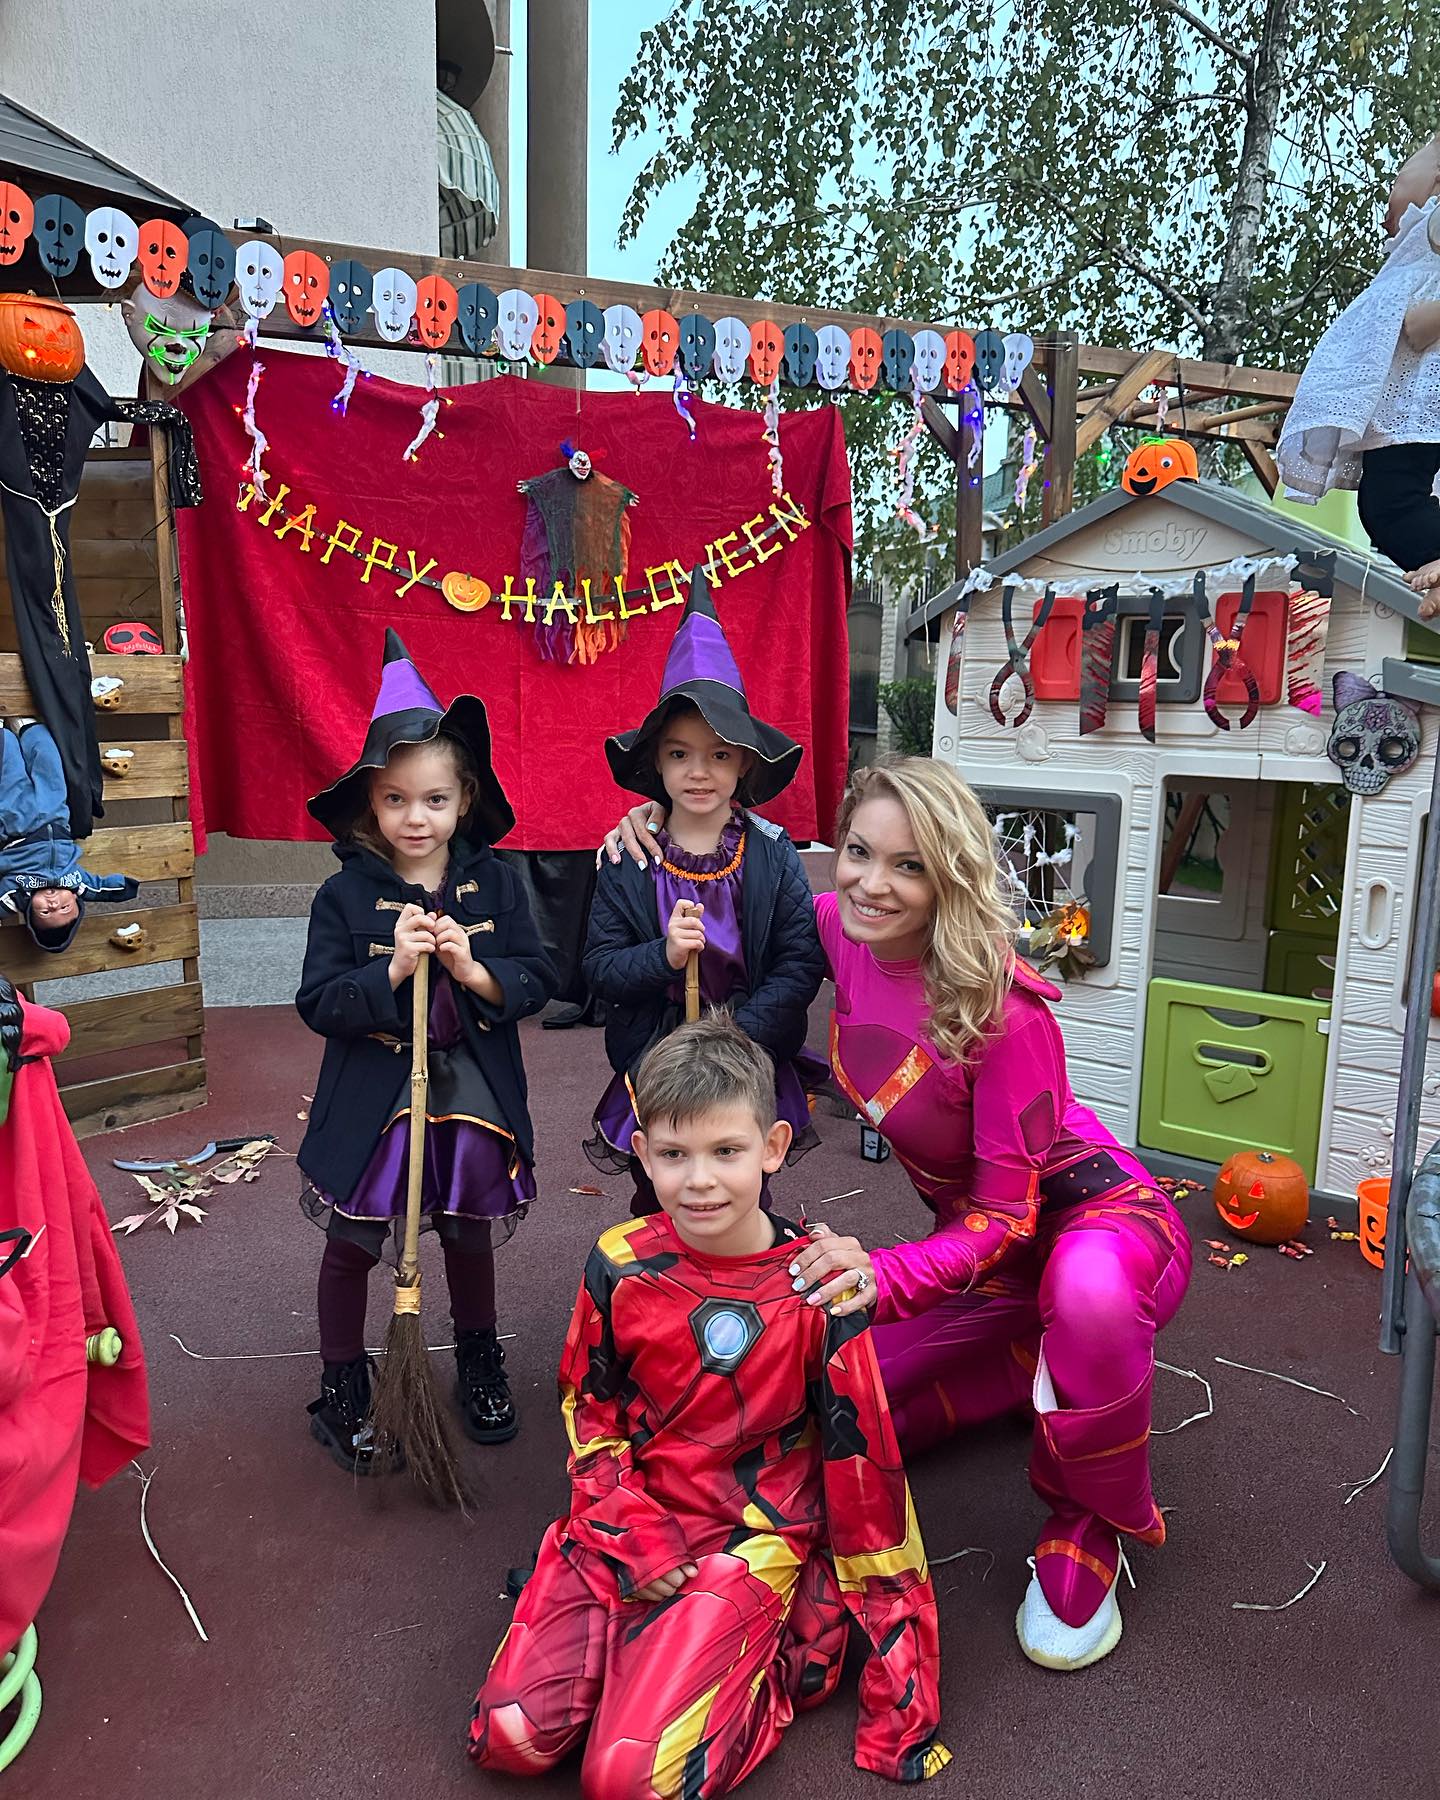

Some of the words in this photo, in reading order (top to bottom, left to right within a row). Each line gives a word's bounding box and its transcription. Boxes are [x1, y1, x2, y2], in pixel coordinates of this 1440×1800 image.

[237, 483, 438, 597] HAPPY
[501, 492, 811, 625] HALLOWEEN
[1104, 522, 1208, 561] Smoby
